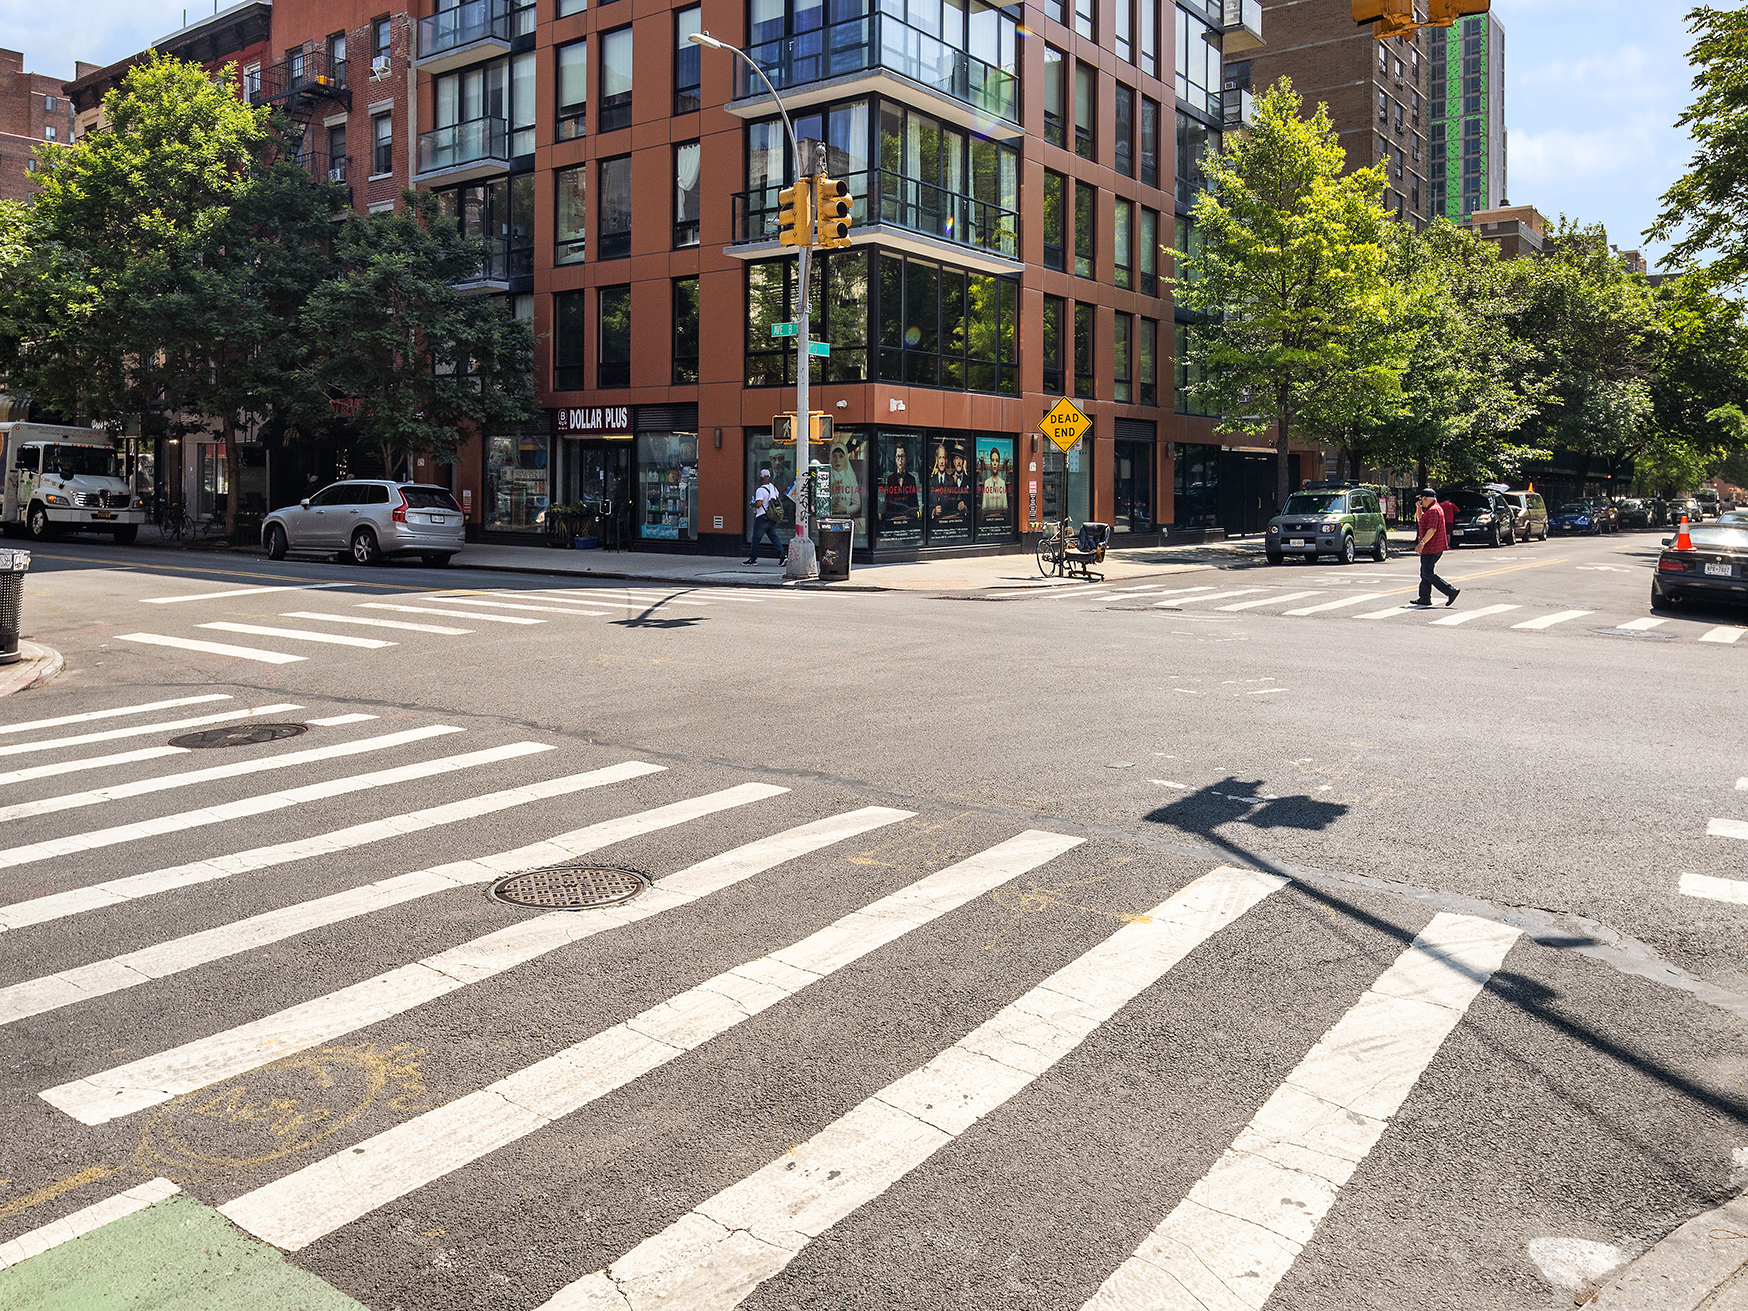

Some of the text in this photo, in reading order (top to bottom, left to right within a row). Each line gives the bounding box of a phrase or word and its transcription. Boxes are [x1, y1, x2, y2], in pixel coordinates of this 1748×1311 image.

[774, 324, 793, 335] AVE B
[569, 407, 628, 429] DOLLAR PLUS
[1050, 413, 1079, 424] DEAD
[1054, 427, 1075, 437] END
[879, 485, 921, 494] PHOENICIAN
[930, 486, 969, 495] PHOENICIAN
[977, 486, 1012, 494] PHOENICIAN
